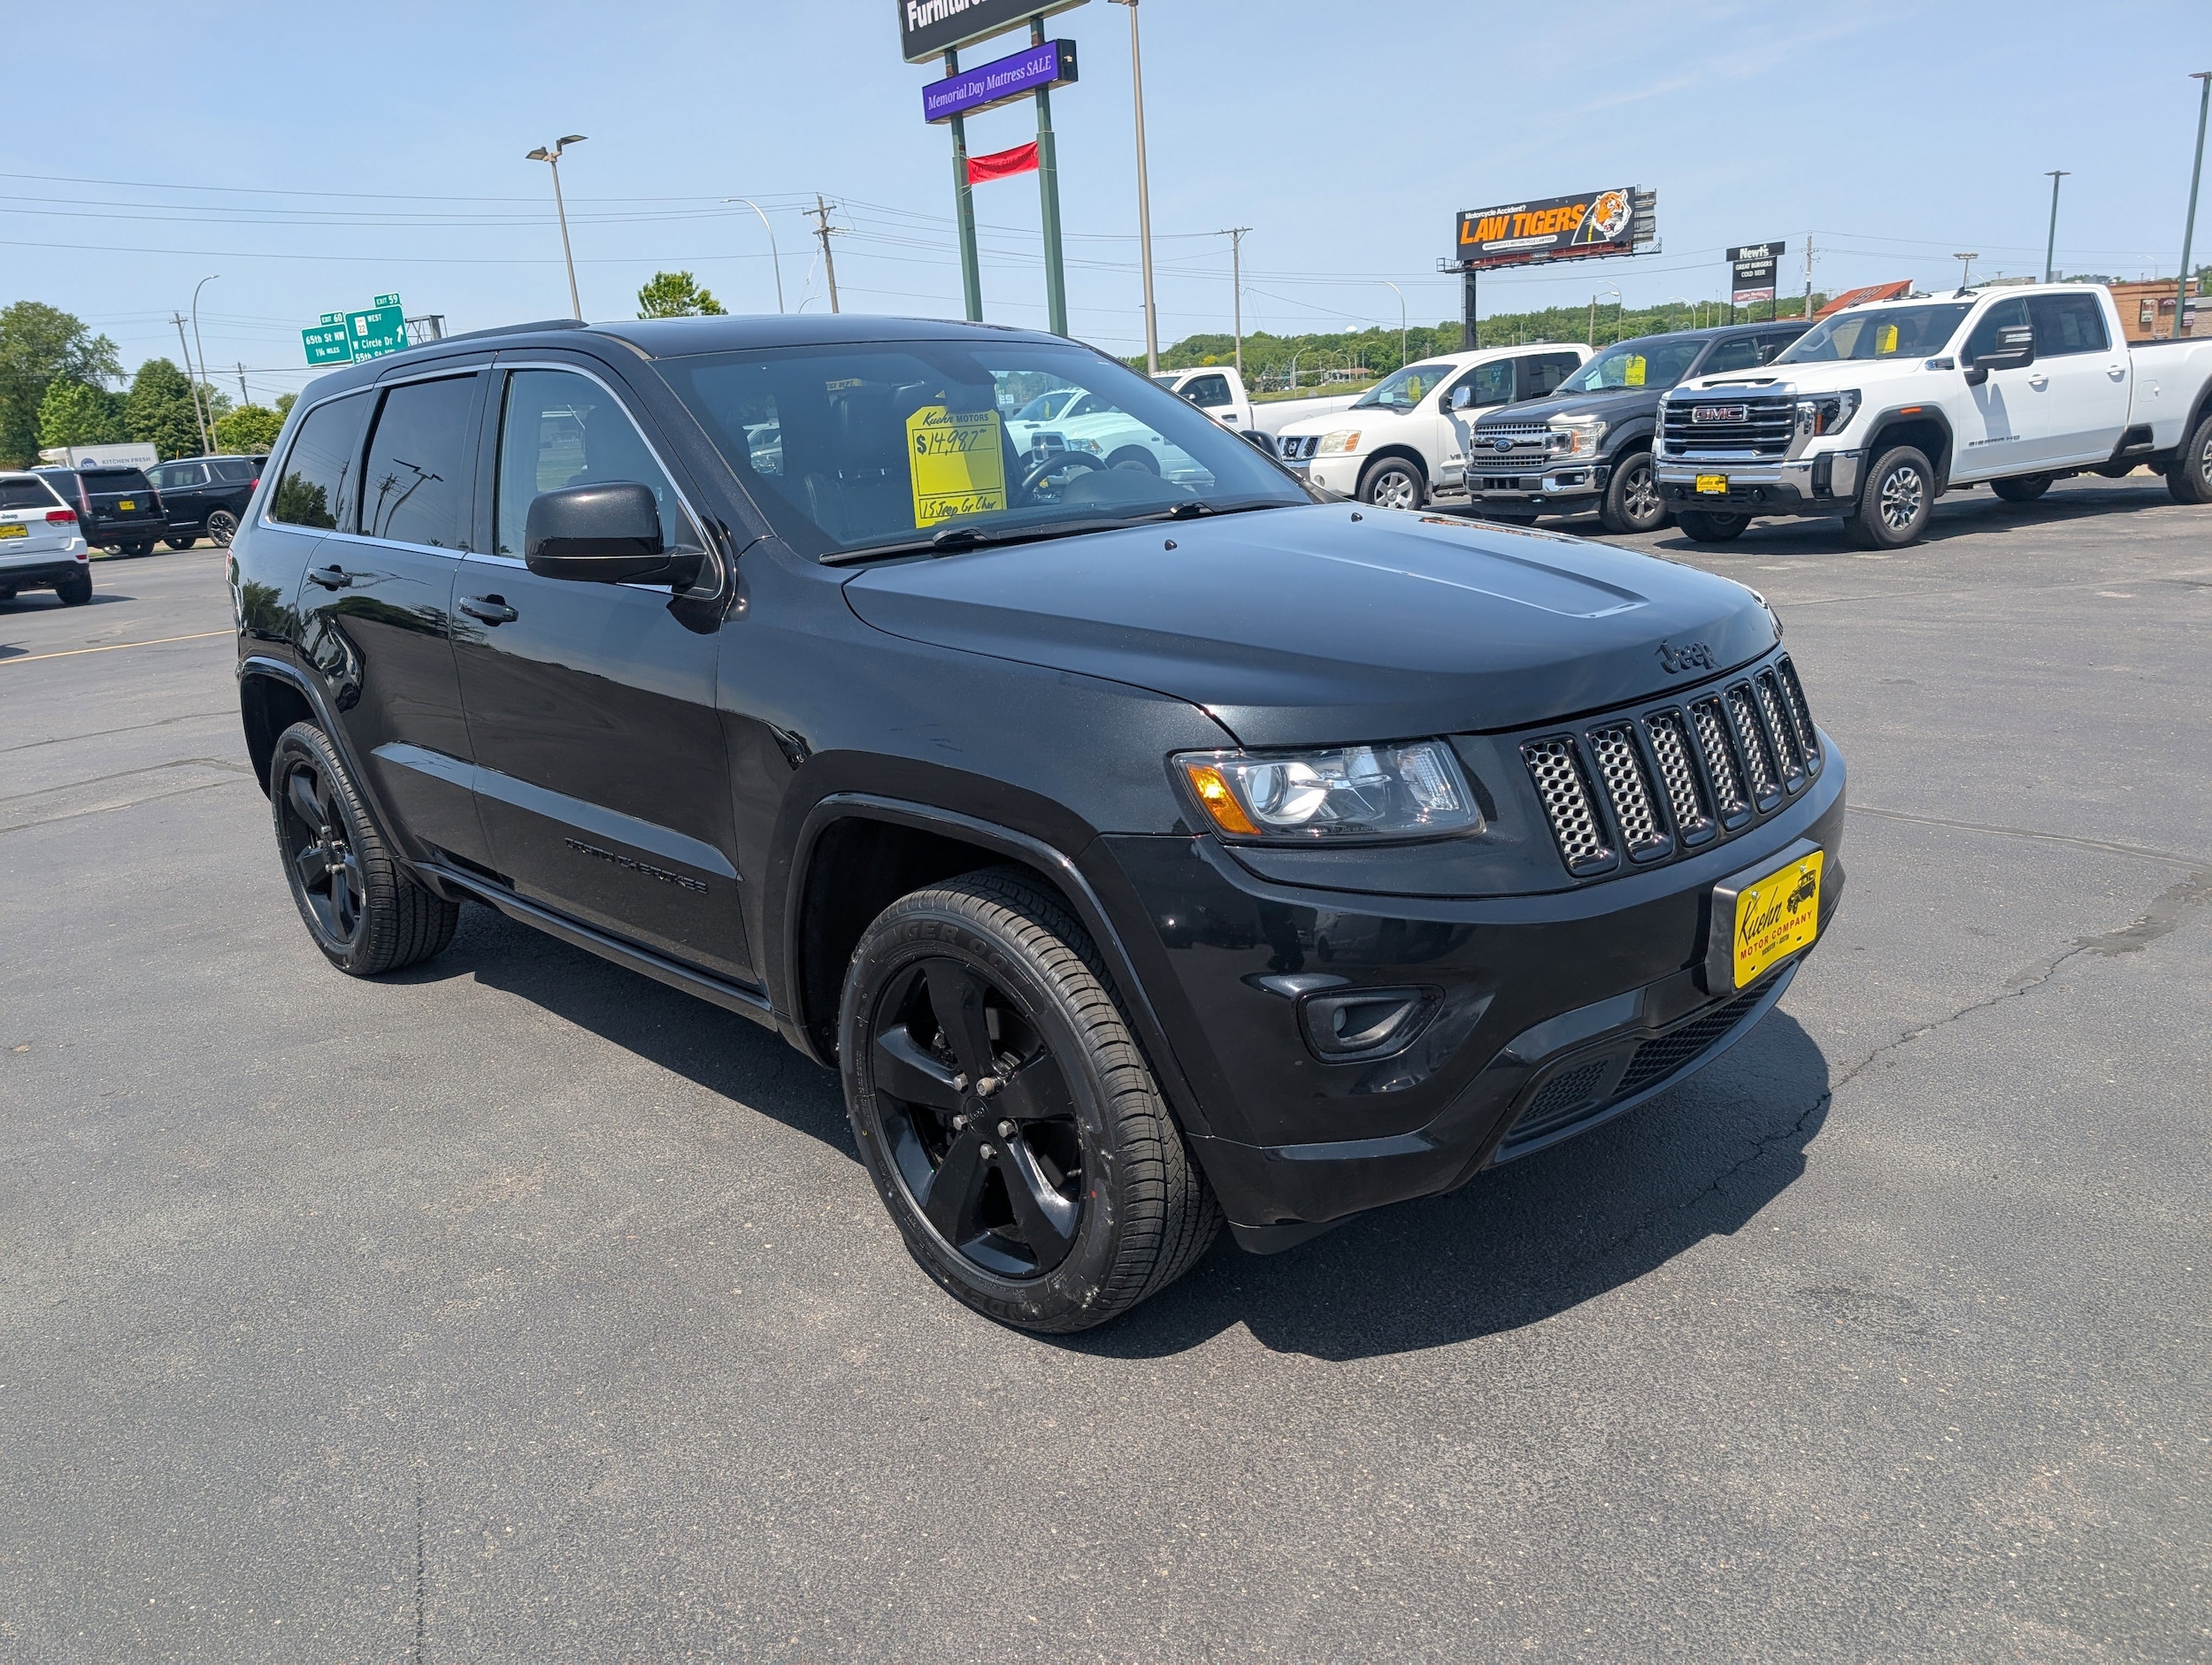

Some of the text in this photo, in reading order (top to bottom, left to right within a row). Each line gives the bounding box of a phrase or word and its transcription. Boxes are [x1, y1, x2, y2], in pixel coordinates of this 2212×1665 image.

[928, 55, 1052, 110] Memorial Day Mattress SALE
[1464, 204, 1526, 219] Motorcycle Accident?
[1460, 203, 1586, 245] LAW TIGERS
[1740, 243, 1769, 259] Newt's
[1751, 260, 1773, 269] BURGERS
[388, 295, 398, 304] 59
[334, 313, 342, 323] 60
[367, 313, 382, 322] WEST
[357, 325, 366, 334] 22
[305, 331, 345, 345] 65th St NW
[352, 336, 393, 349] W Circle Dr
[355, 352, 372, 363] 55th
[923, 411, 989, 426] Kuehn MOTORS
[1696, 407, 1743, 420] GMC
[1968, 437, 2005, 447] SIERRA
[1657, 640, 1715, 674] Jeep
[1737, 886, 1783, 948] Kuehn
[1740, 909, 1812, 961] MOTOR COMPANY
